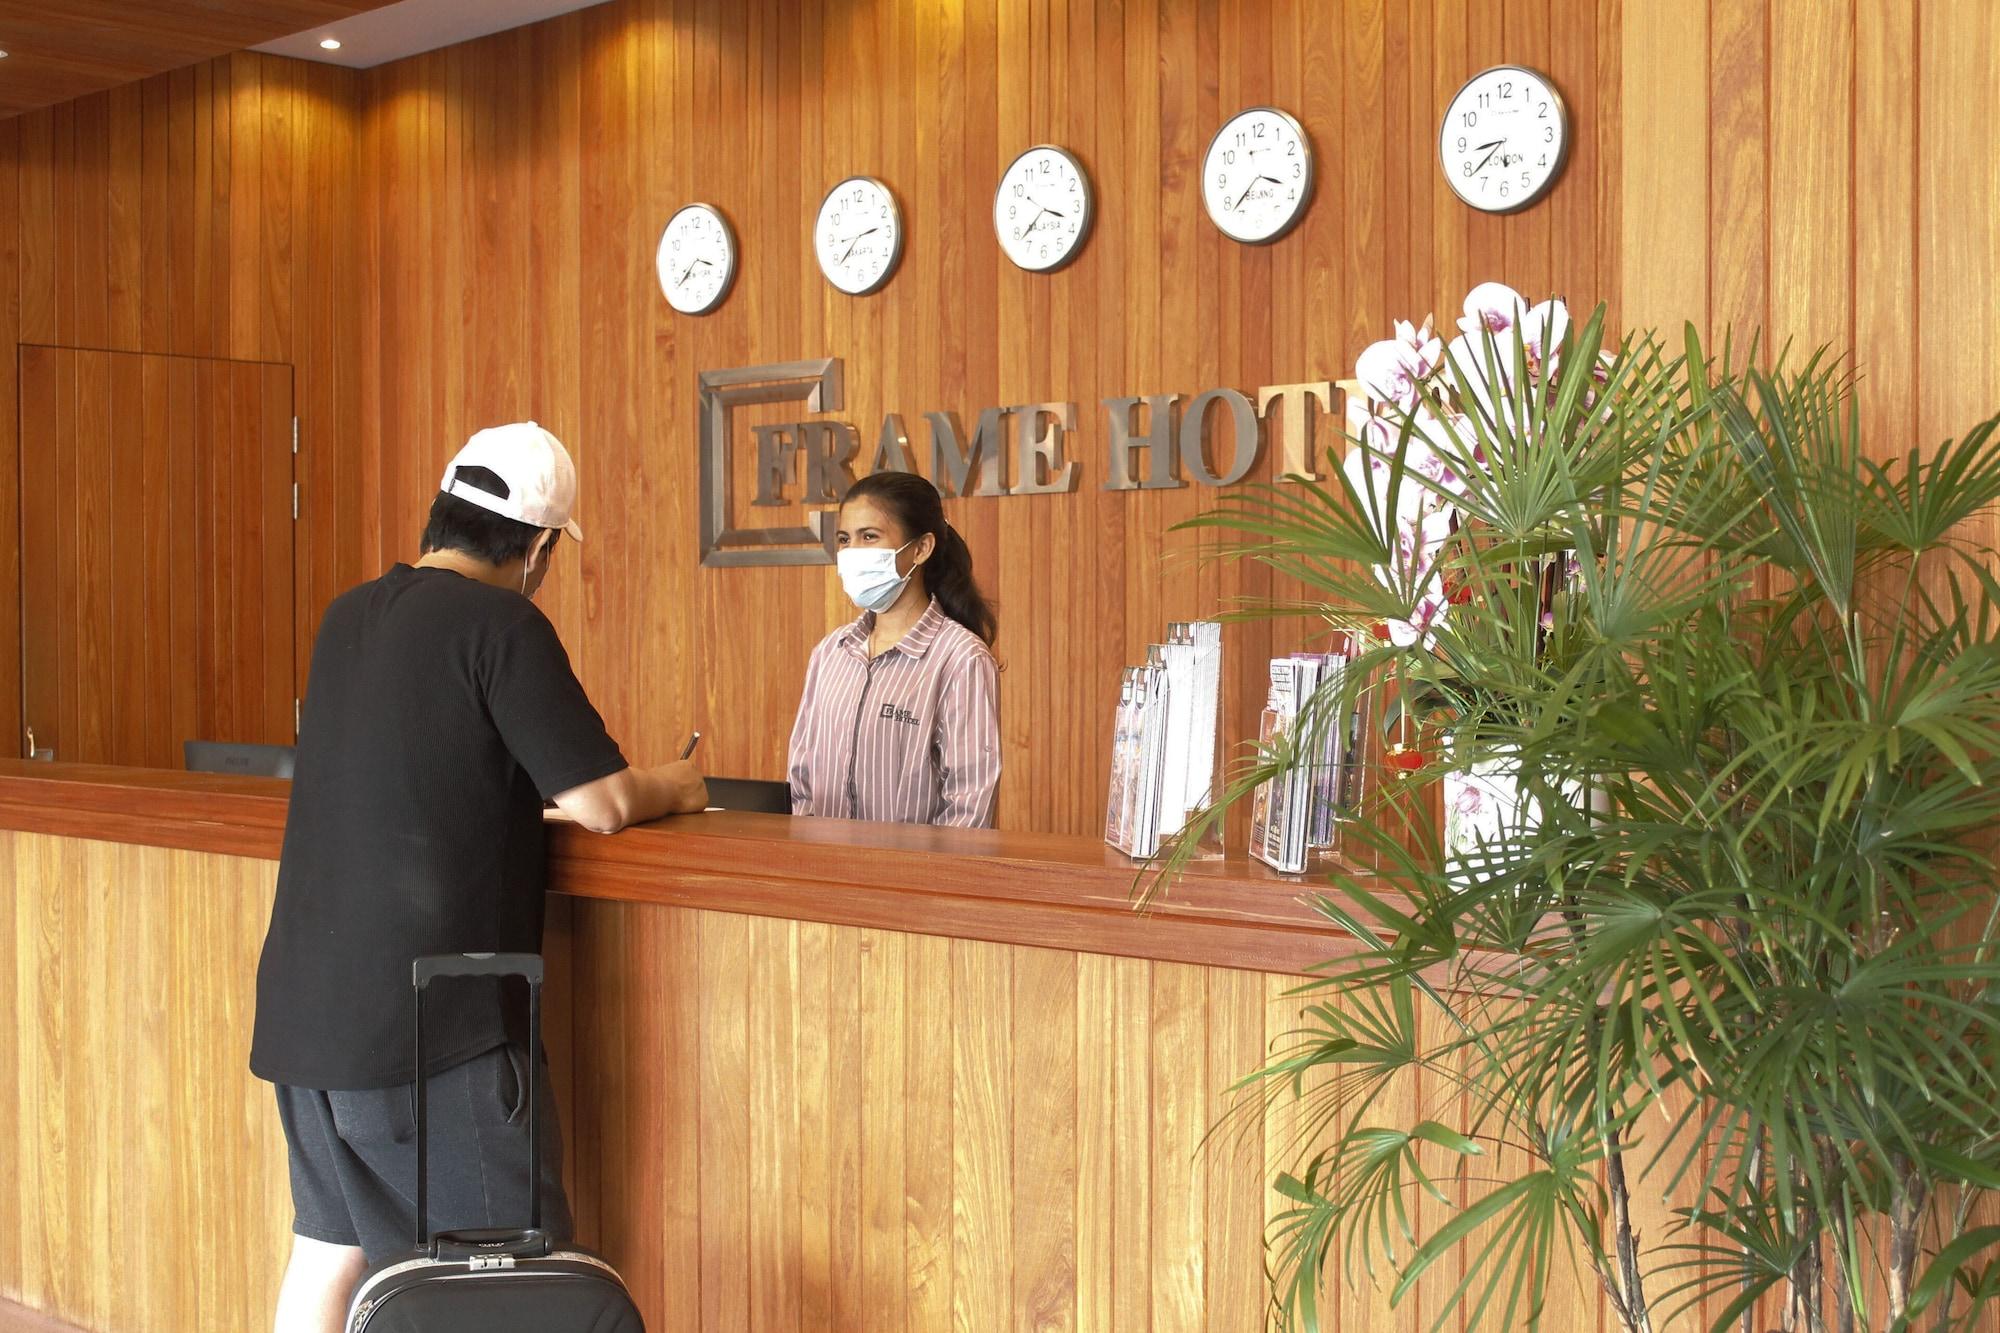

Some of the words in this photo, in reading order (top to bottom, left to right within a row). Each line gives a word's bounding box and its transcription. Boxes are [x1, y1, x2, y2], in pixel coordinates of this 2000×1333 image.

[1497, 82, 1512, 99] 12
[1478, 93, 1489, 109] 11
[1538, 102, 1548, 118] 2
[1462, 111, 1477, 128] 10
[1252, 123, 1265, 138] 12
[1544, 127, 1553, 143] 3
[1236, 133, 1246, 148] 11
[1457, 137, 1467, 153] 9
[1287, 141, 1295, 156] 2
[1223, 150, 1235, 165] 10
[1538, 153, 1546, 168] 4
[1039, 160, 1050, 174] 12
[1293, 163, 1301, 178] 3
[1463, 161, 1473, 178] 8
[1025, 168, 1034, 182] 11
[1219, 173, 1227, 189] 9
[1521, 171, 1531, 188] 5
[1013, 184, 1024, 198] 10
[1069, 178, 1075, 192] 2
[1480, 176, 1488, 192] 7
[1500, 180, 1509, 197] 6
[853, 189, 863, 203] 12
[1287, 188, 1295, 200] 4
[840, 197, 848, 210] 11
[1074, 200, 1080, 213] 3
[1223, 196, 1232, 211] 8
[881, 205, 887, 219] 2
[1009, 205, 1016, 219] 9
[691, 216, 701, 229] 12
[831, 213, 840, 226] 10
[681, 225, 688, 237] 11
[886, 225, 892, 238] 3
[1013, 227, 1020, 240] 8
[1068, 223, 1075, 234] 4
[716, 231, 721, 243] 2
[672, 240, 680, 251] 10
[1026, 240, 1032, 253] 7
[1057, 237, 1063, 252] 5
[1040, 245, 1047, 259] 6
[872, 261, 878, 275] 5
[857, 269, 864, 282] 6
[752, 401, 1083, 506] FRAME
[1101, 369, 1450, 490] HOT
